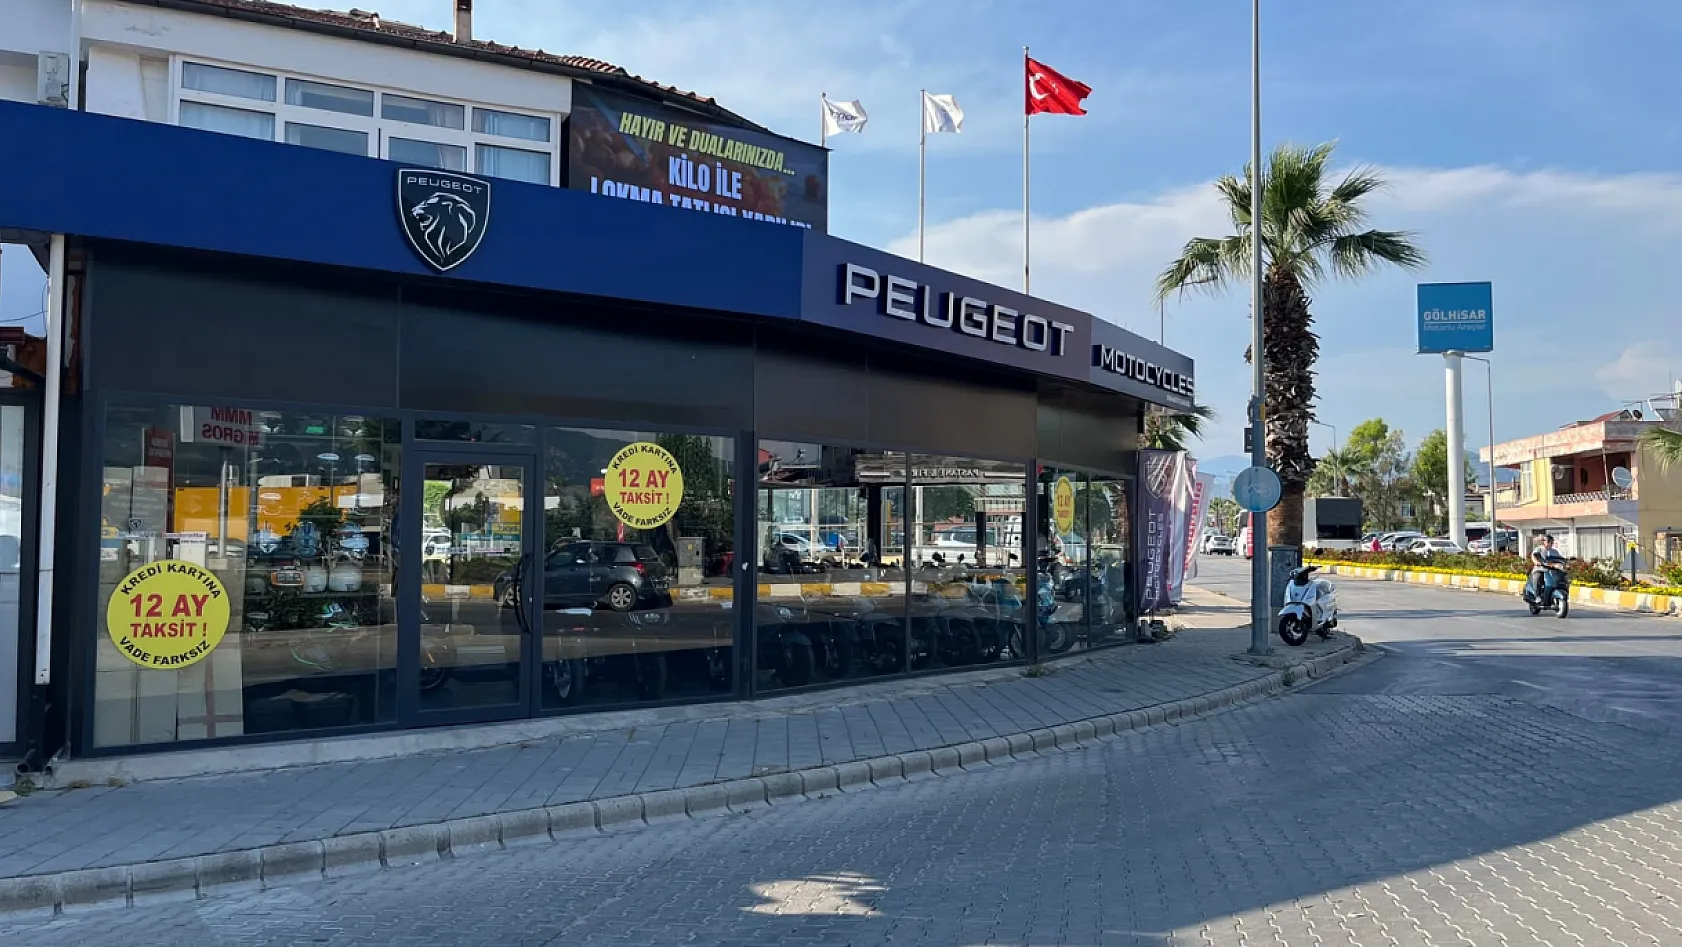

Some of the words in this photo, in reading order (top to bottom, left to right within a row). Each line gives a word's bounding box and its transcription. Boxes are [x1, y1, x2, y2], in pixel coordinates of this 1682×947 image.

[619, 112, 665, 142] HAYIR
[668, 123, 685, 148] VE
[407, 176, 482, 194] PEUGEOT
[668, 153, 711, 193] KİLO
[715, 162, 743, 200] İLE
[844, 262, 1075, 357] PEUGEOT
[1101, 344, 1194, 396] MOTOCYCLES
[612, 445, 638, 470] KREDİ
[618, 468, 640, 488] 12
[645, 470, 670, 488] AY
[619, 489, 662, 505] TAKSİT
[613, 502, 634, 524] VADE
[635, 507, 672, 526] FARKSIZ
[1147, 508, 1157, 600] PEUGEOT
[121, 563, 162, 595] KREDİ
[167, 563, 221, 598] KARTINA
[130, 593, 163, 618] 12
[171, 594, 209, 617] AY
[130, 620, 197, 638] TAKSİT
[120, 636, 151, 662] VADE
[153, 640, 210, 665] FARKSIZ
